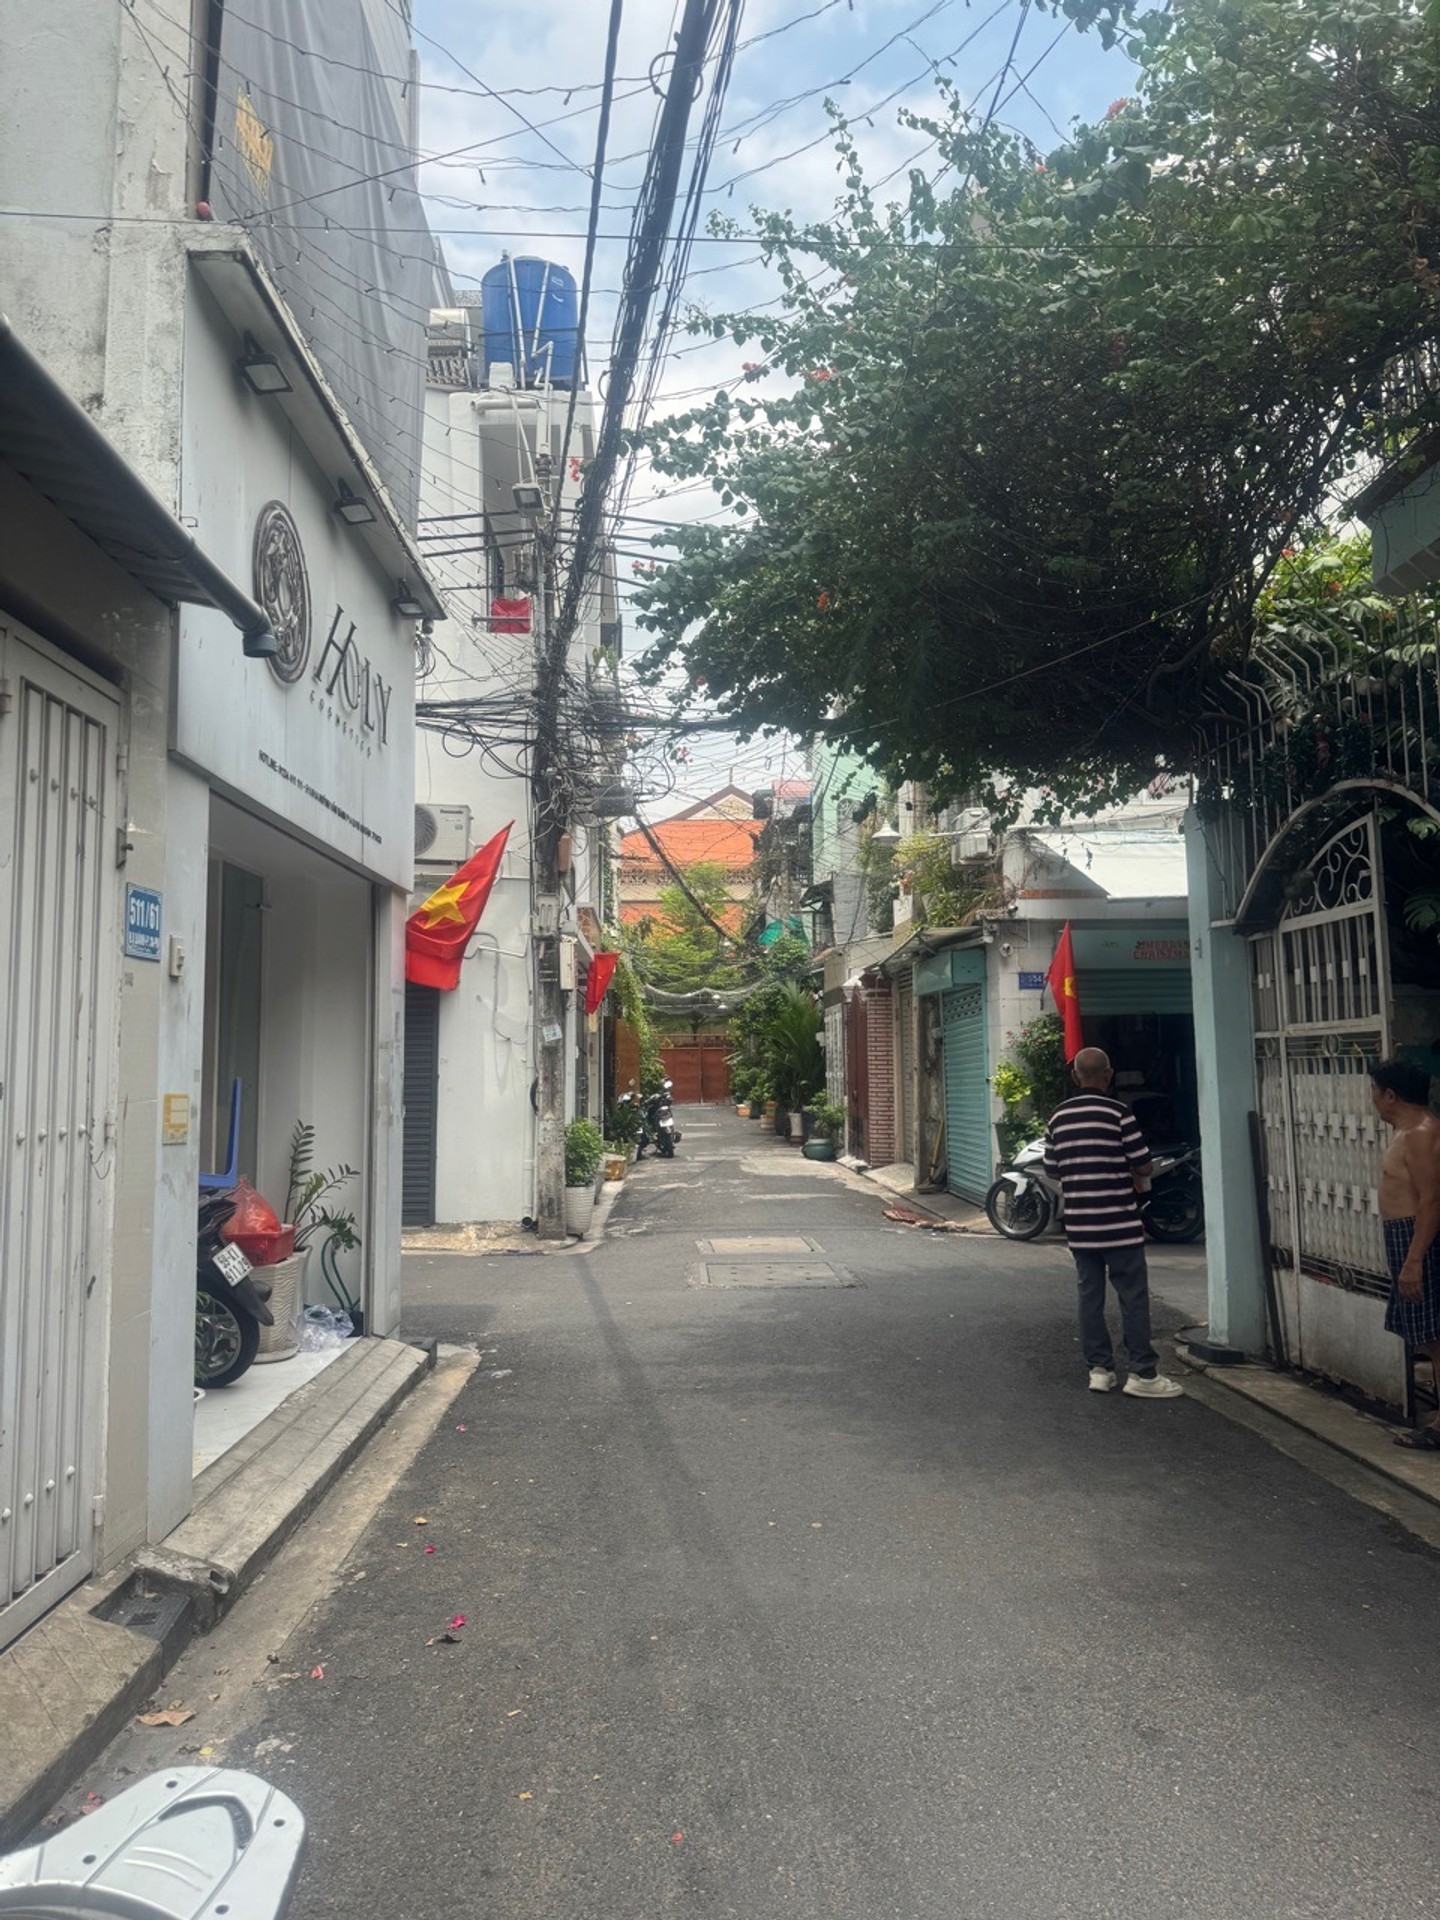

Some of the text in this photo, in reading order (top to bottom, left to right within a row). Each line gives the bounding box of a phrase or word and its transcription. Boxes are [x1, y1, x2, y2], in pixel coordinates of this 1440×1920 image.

[312, 603, 392, 745] HOLY
[309, 690, 372, 758] COSMETICS
[129, 897, 159, 931] 511/61
